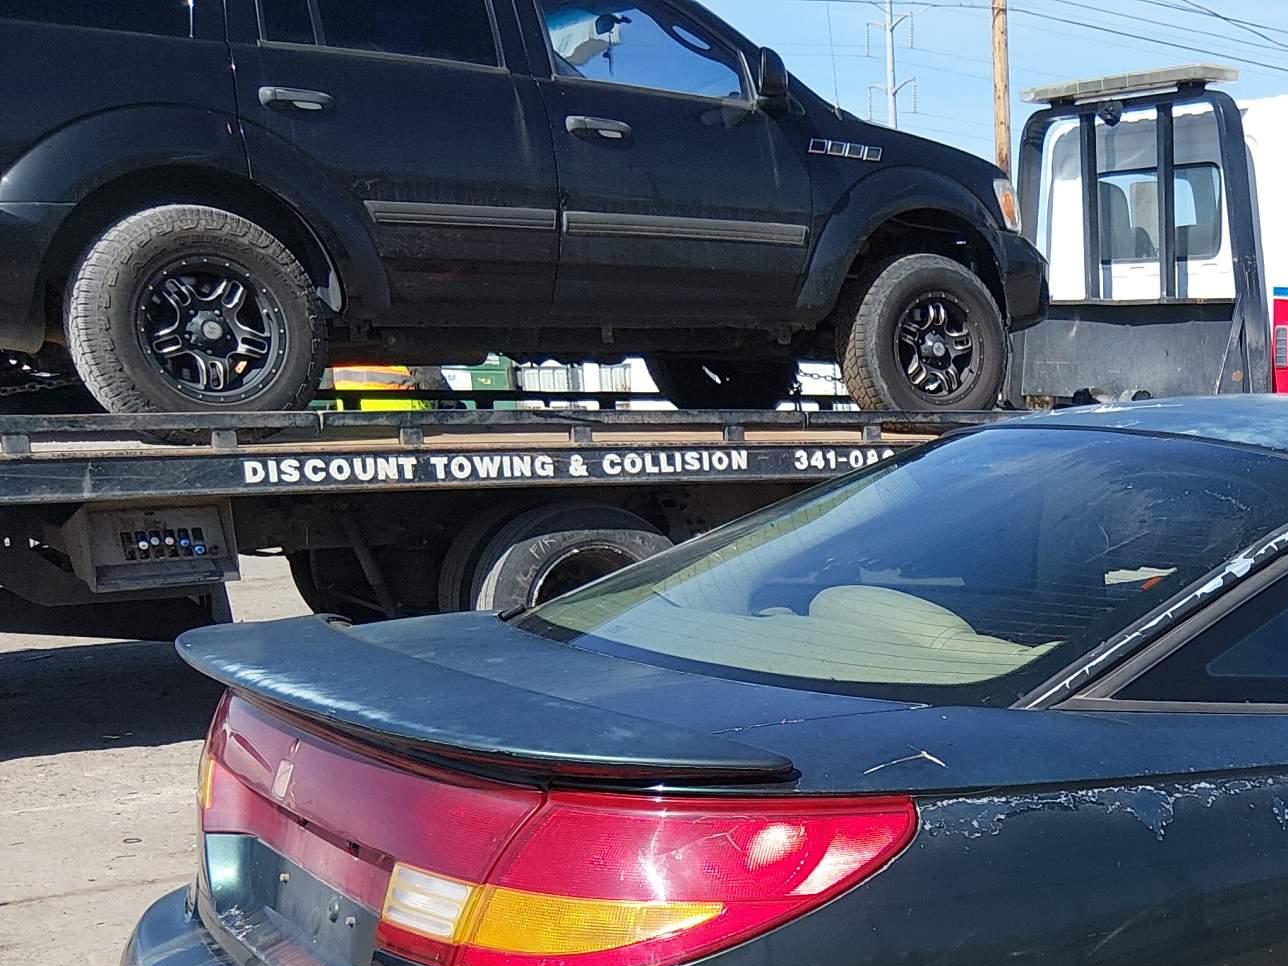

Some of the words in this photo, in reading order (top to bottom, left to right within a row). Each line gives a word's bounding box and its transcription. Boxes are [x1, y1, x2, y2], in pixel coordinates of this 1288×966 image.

[244, 456, 417, 483] DISCOUNT
[430, 455, 554, 479] TOWING
[568, 454, 589, 477] &
[602, 450, 748, 475] COLLISION
